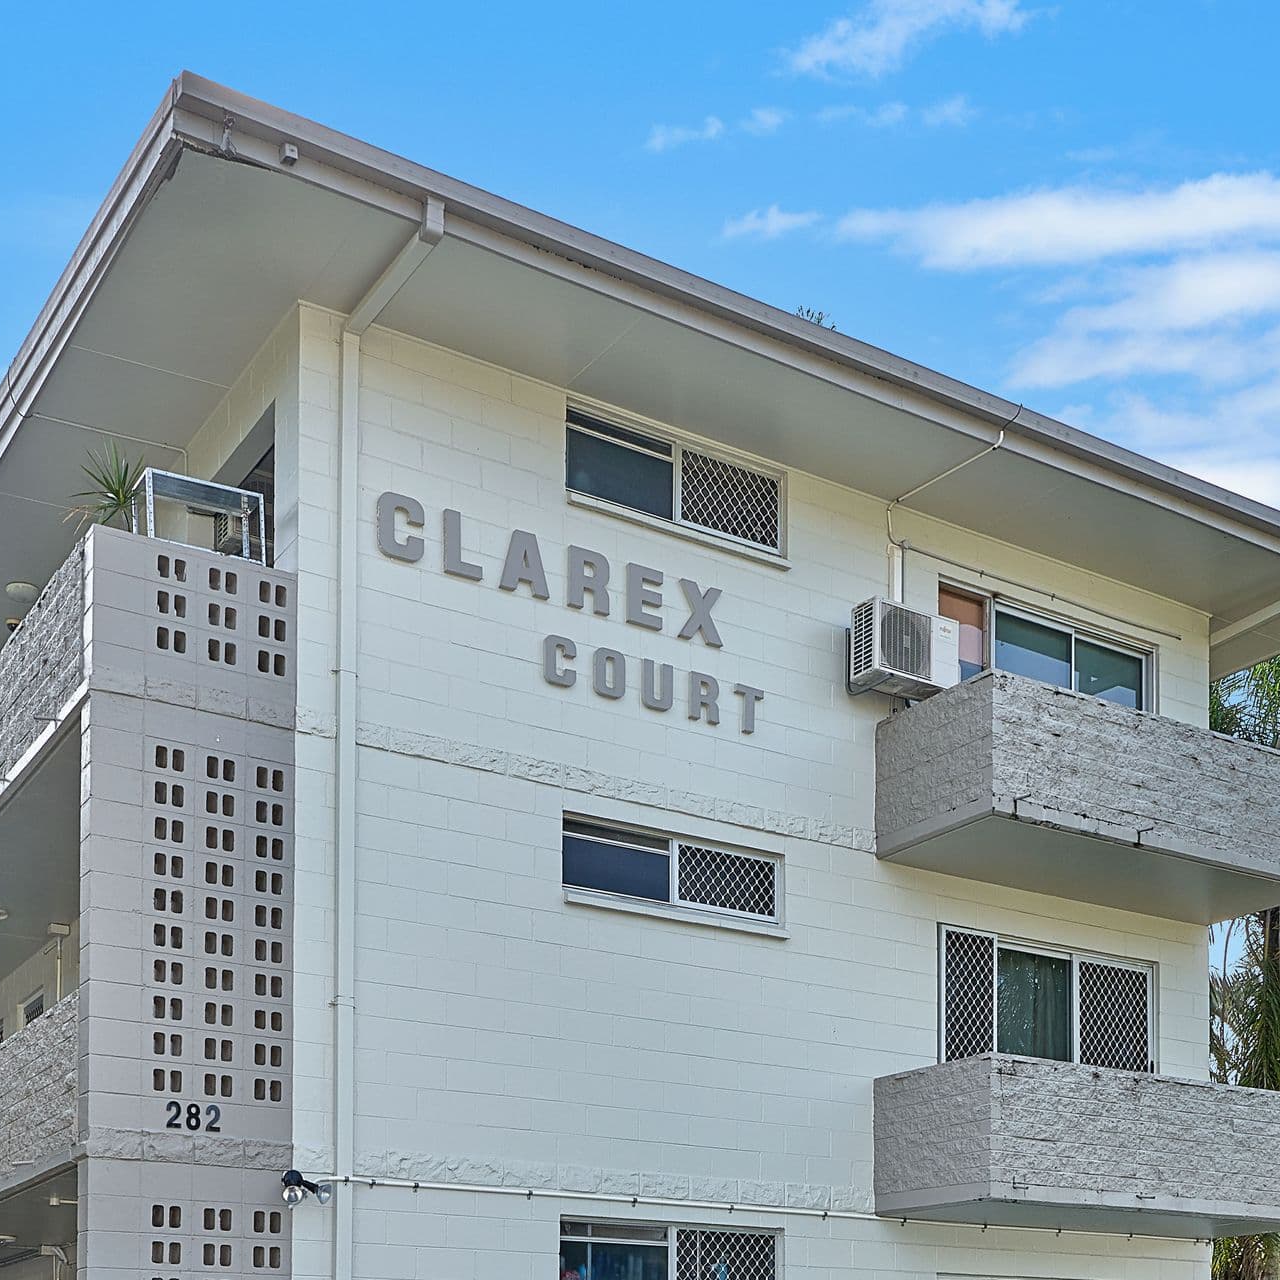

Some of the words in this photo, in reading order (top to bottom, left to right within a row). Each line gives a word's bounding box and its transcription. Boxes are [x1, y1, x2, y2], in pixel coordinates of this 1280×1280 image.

[376, 491, 723, 648] CLAREX
[542, 634, 765, 735] COURT
[166, 1101, 221, 1132] 282
